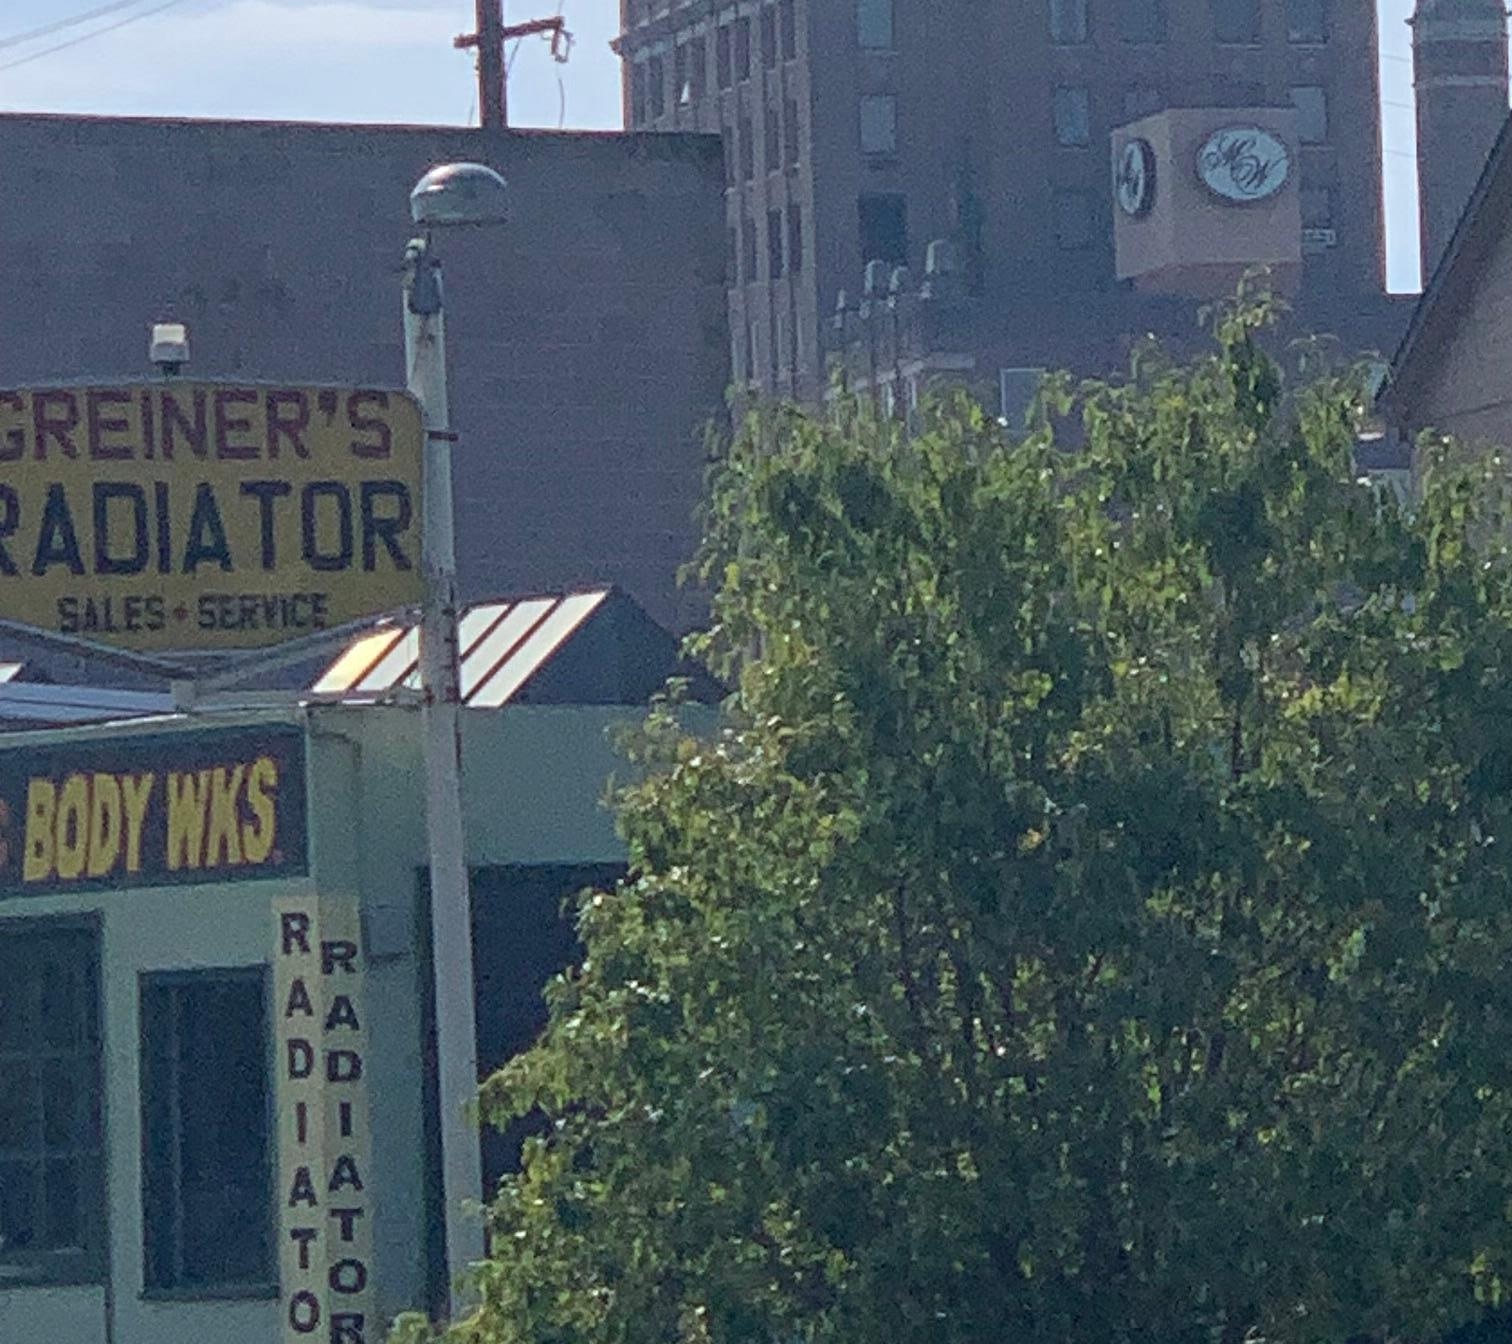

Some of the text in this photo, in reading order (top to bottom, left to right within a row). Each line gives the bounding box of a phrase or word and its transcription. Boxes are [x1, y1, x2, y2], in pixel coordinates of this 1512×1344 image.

[0, 389, 392, 460] GREINER'S
[57, 592, 328, 632] SALES SERVICE
[23, 772, 154, 881] BODY
